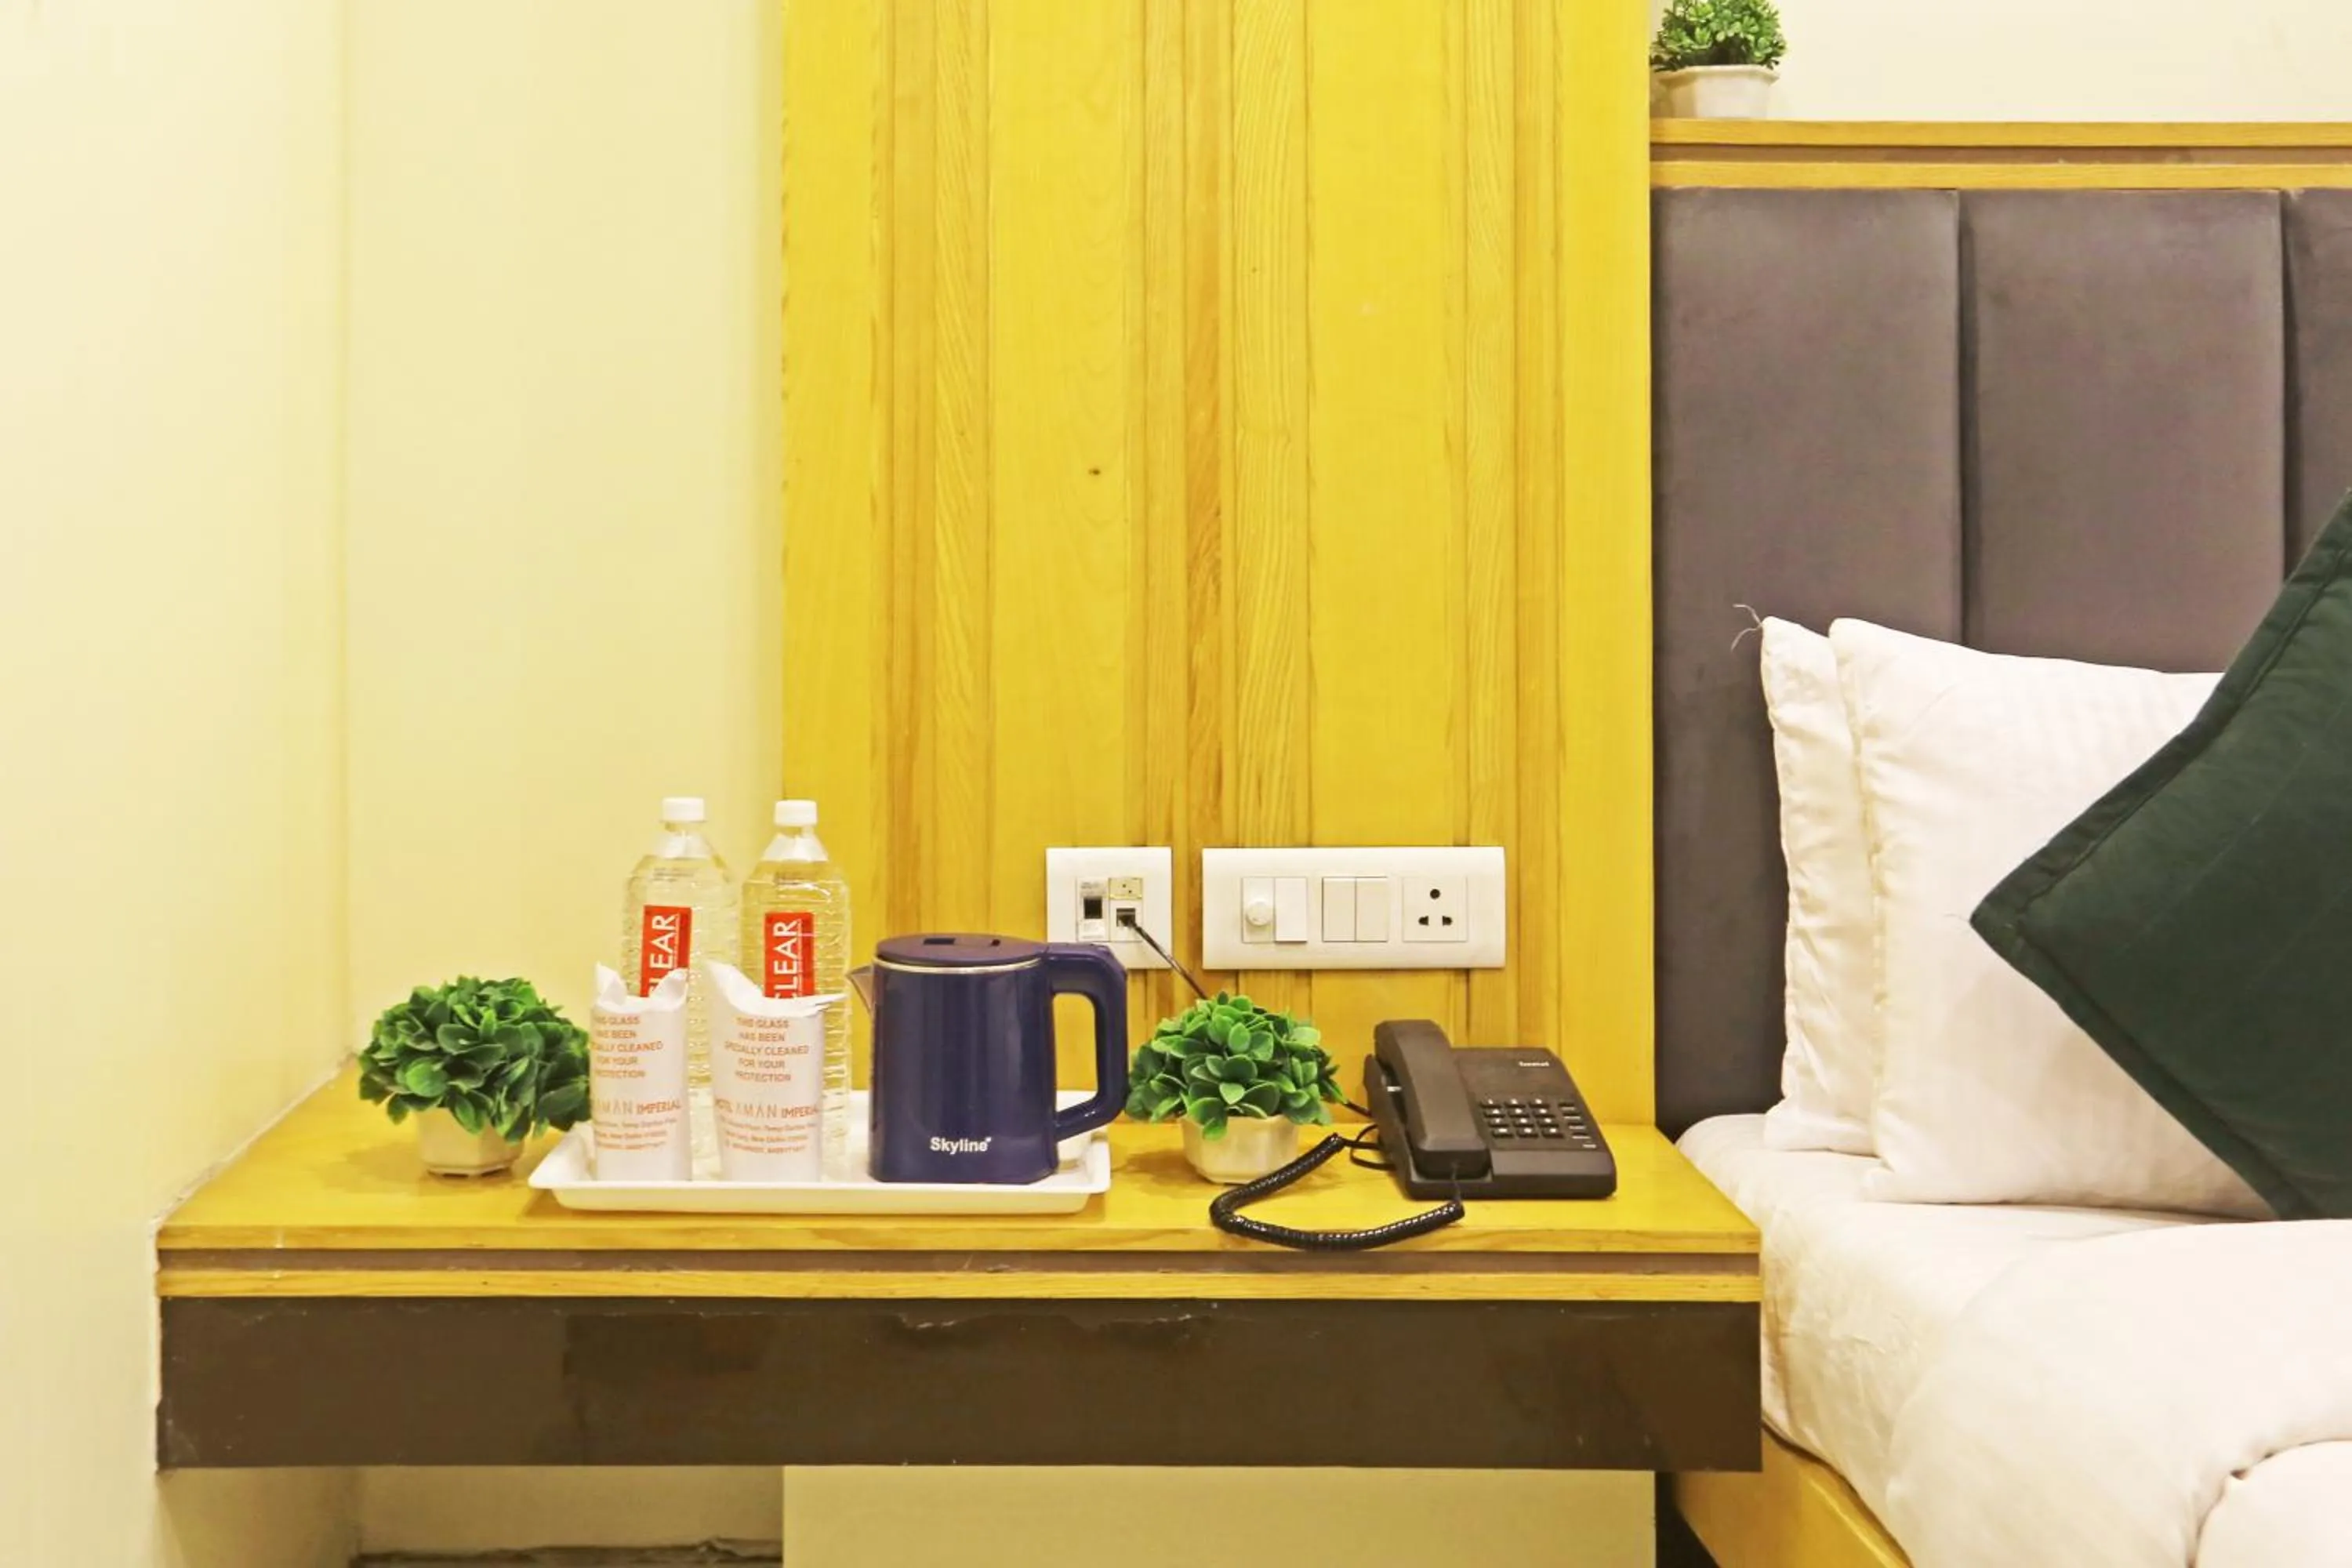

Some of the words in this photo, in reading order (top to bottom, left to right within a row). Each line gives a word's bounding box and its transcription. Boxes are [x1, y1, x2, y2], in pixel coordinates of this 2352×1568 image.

[649, 913, 677, 996] EAR
[773, 920, 798, 999] LEAR
[608, 1015, 641, 1025] GLASS
[756, 1018, 789, 1028] GLASS
[611, 1030, 637, 1040] BEEN
[757, 1033, 785, 1042] BEEN
[617, 1040, 664, 1053] CLEANED
[764, 1044, 810, 1056] CLEANED
[613, 1056, 638, 1066] YOUR
[738, 1058, 755, 1067] FOR
[757, 1060, 786, 1069] YOUR
[735, 1069, 792, 1083] PROTECTION
[636, 1098, 682, 1115] IMPERIAL
[930, 1136, 989, 1156] Skyline
